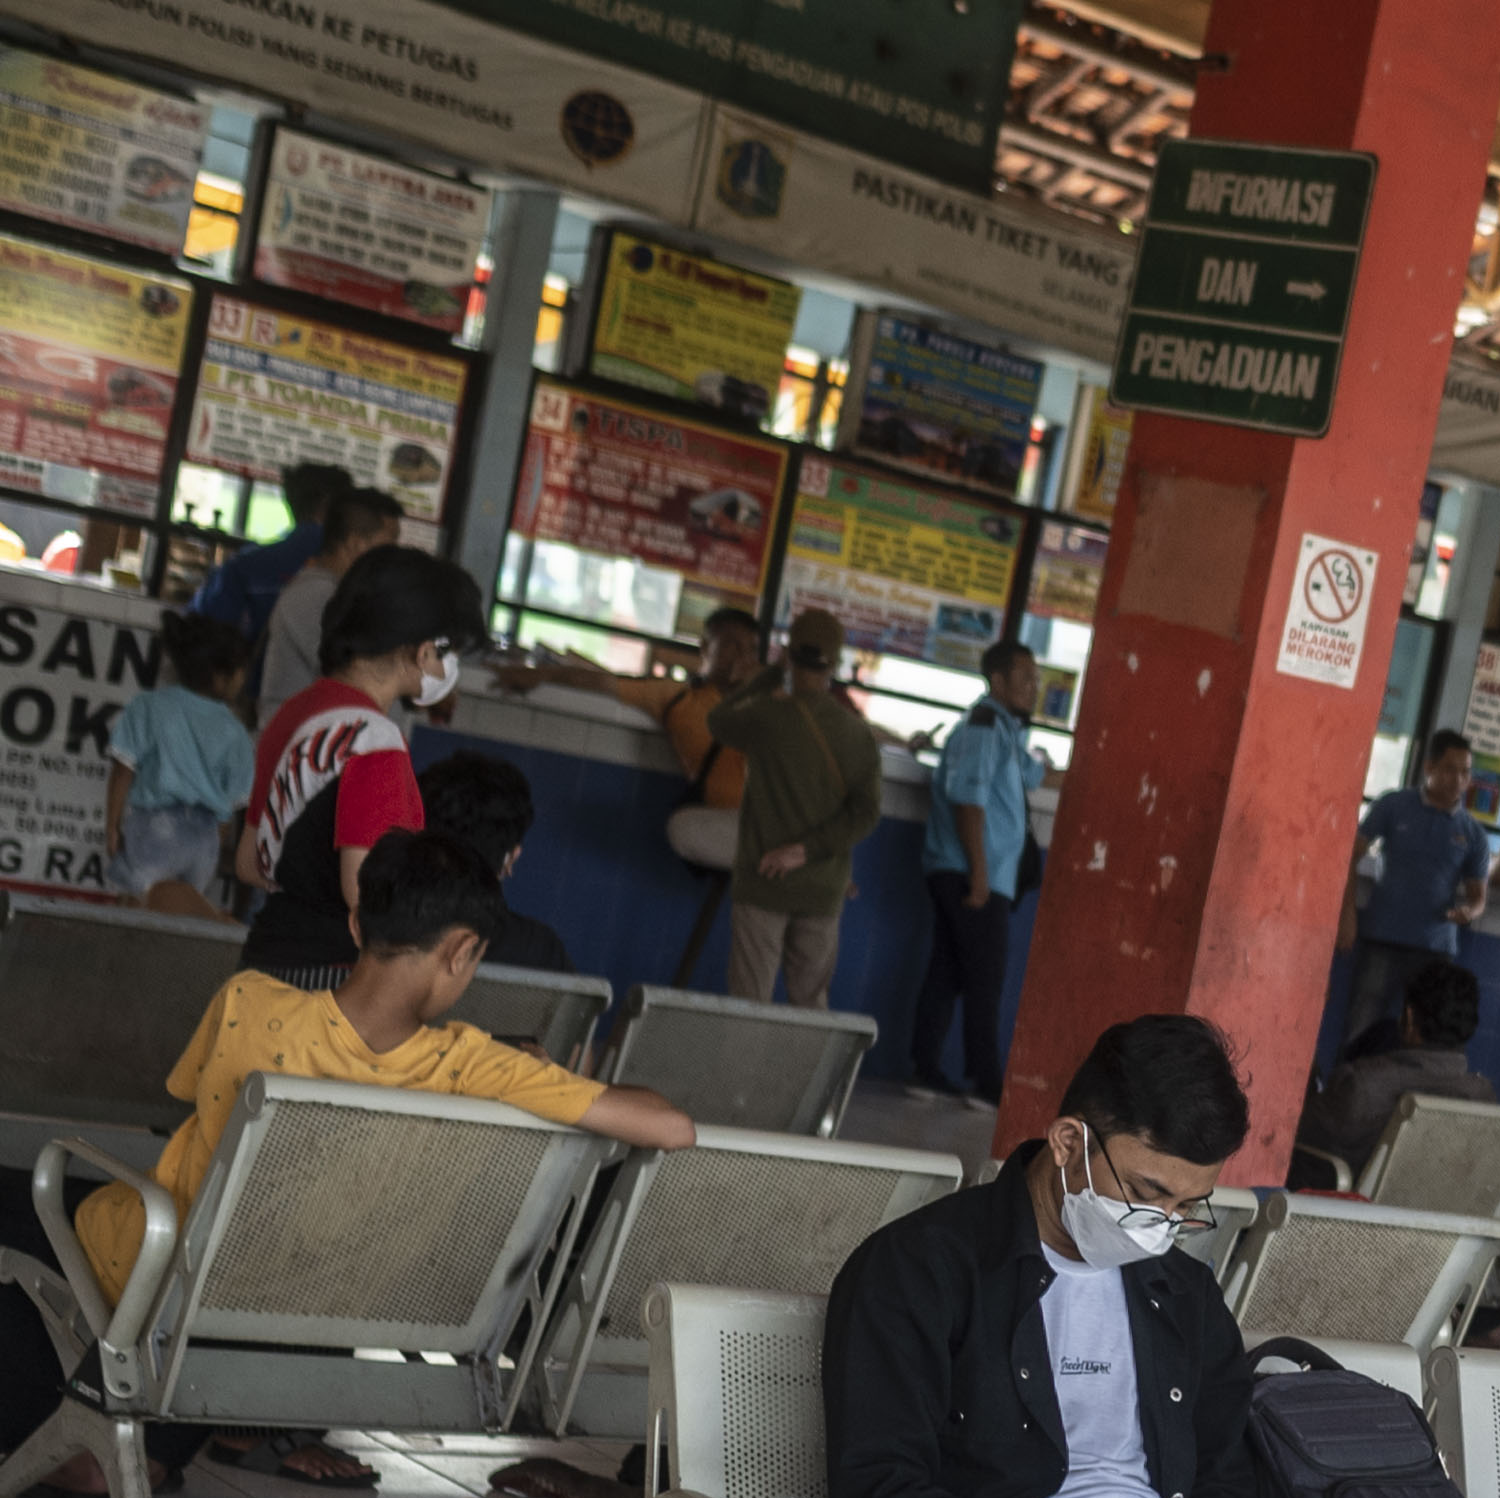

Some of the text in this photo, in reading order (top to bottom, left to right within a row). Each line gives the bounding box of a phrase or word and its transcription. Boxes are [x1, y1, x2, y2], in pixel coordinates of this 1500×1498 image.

[258, 34, 317, 70] YANG
[851, 166, 1121, 287] PASTIKAN TIKET YANG
[1197, 257, 1258, 307] DAN
[1130, 331, 1320, 400] PENGADUAN
[1284, 640, 1353, 670] MEROKOK
[1287, 626, 1357, 657] DILARANG
